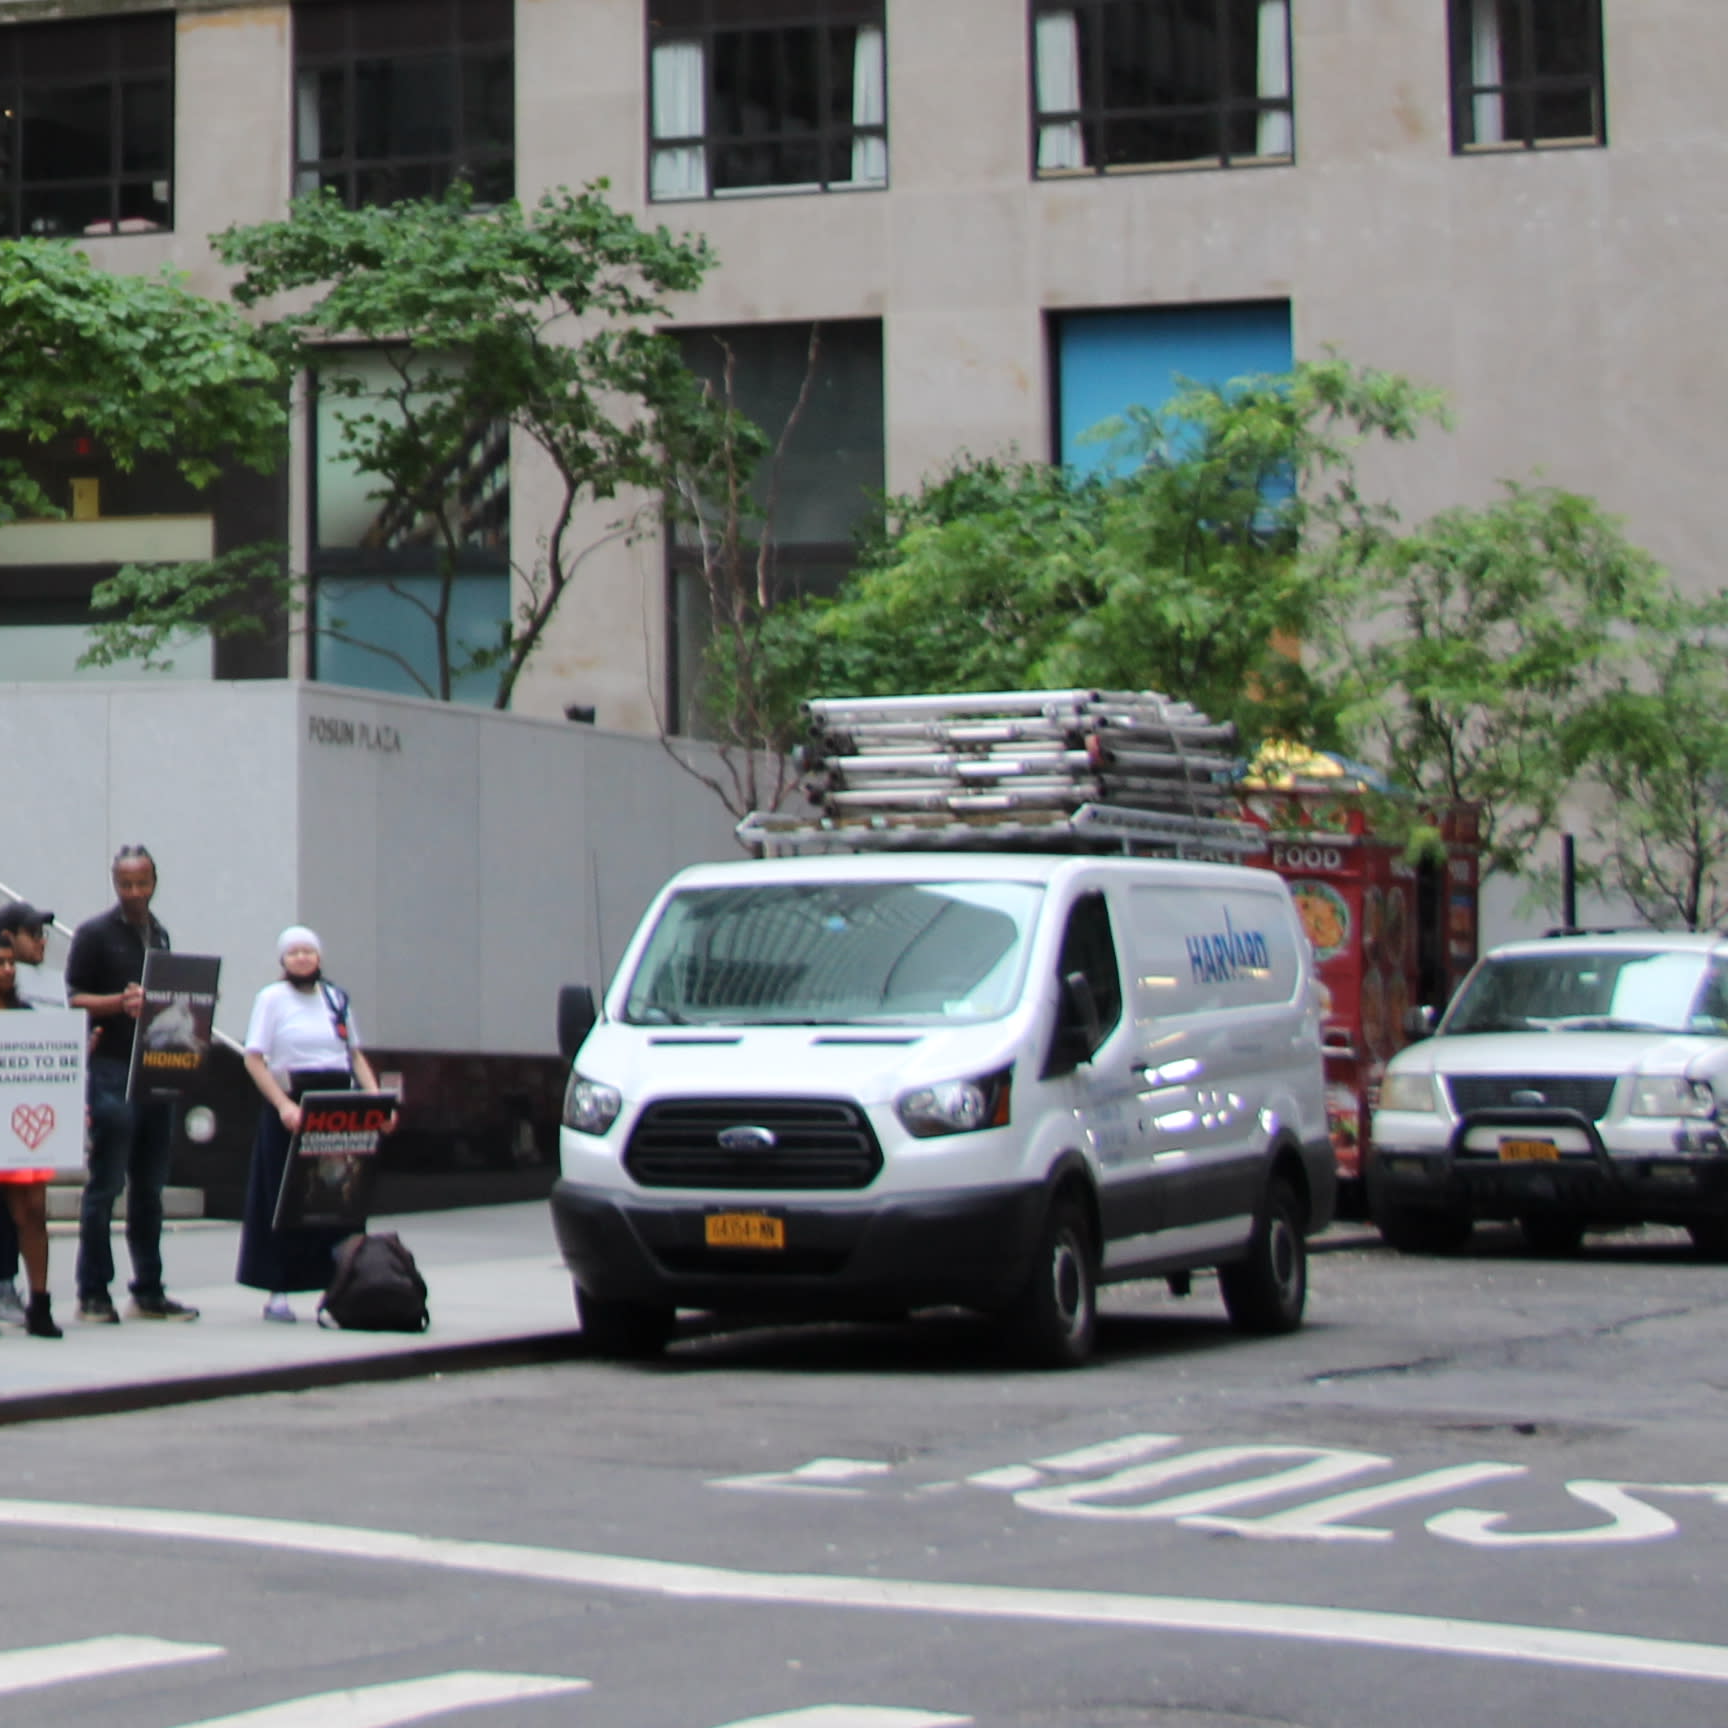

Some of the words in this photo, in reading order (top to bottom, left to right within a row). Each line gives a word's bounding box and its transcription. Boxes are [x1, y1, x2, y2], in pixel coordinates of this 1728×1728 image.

[308, 714, 354, 746] FOSUN
[359, 720, 401, 753] PLAZA
[1273, 845, 1341, 870] FOOD
[1185, 905, 1270, 984] HARVARD
[34, 1055, 55, 1068] TO
[59, 1055, 79, 1068] BE
[306, 1109, 385, 1132] HOLD
